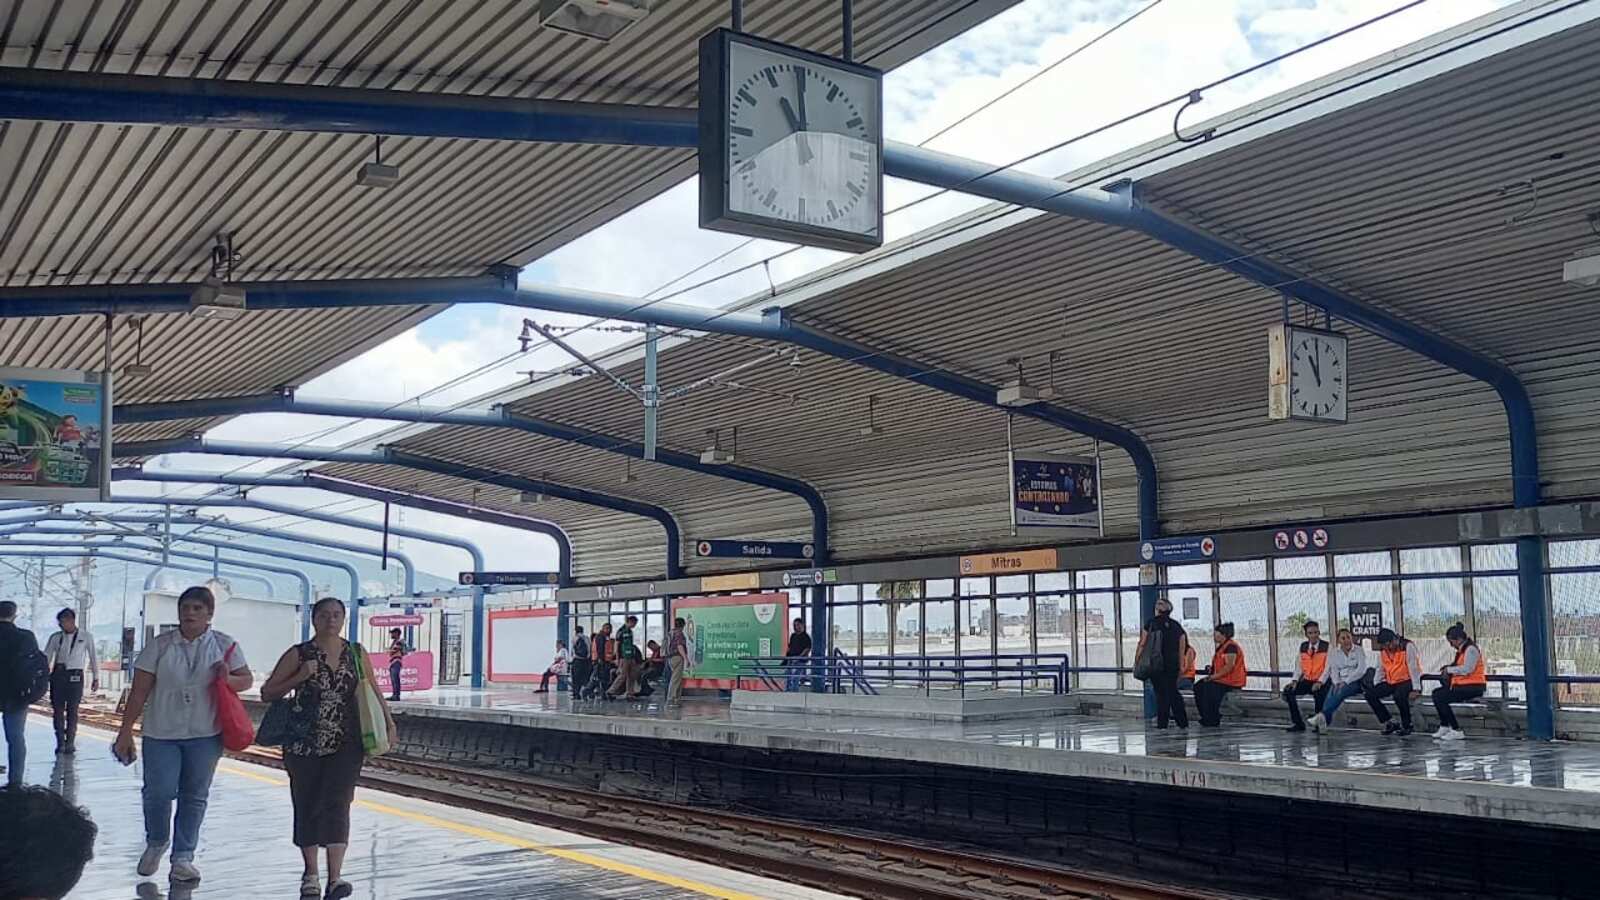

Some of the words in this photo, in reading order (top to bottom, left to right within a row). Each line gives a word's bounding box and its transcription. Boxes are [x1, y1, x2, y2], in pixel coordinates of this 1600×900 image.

[742, 545, 772, 555] Salida
[991, 556, 1022, 568] Mitras
[1351, 613, 1380, 626] WIFI
[1352, 626, 1380, 635] GRATIS
